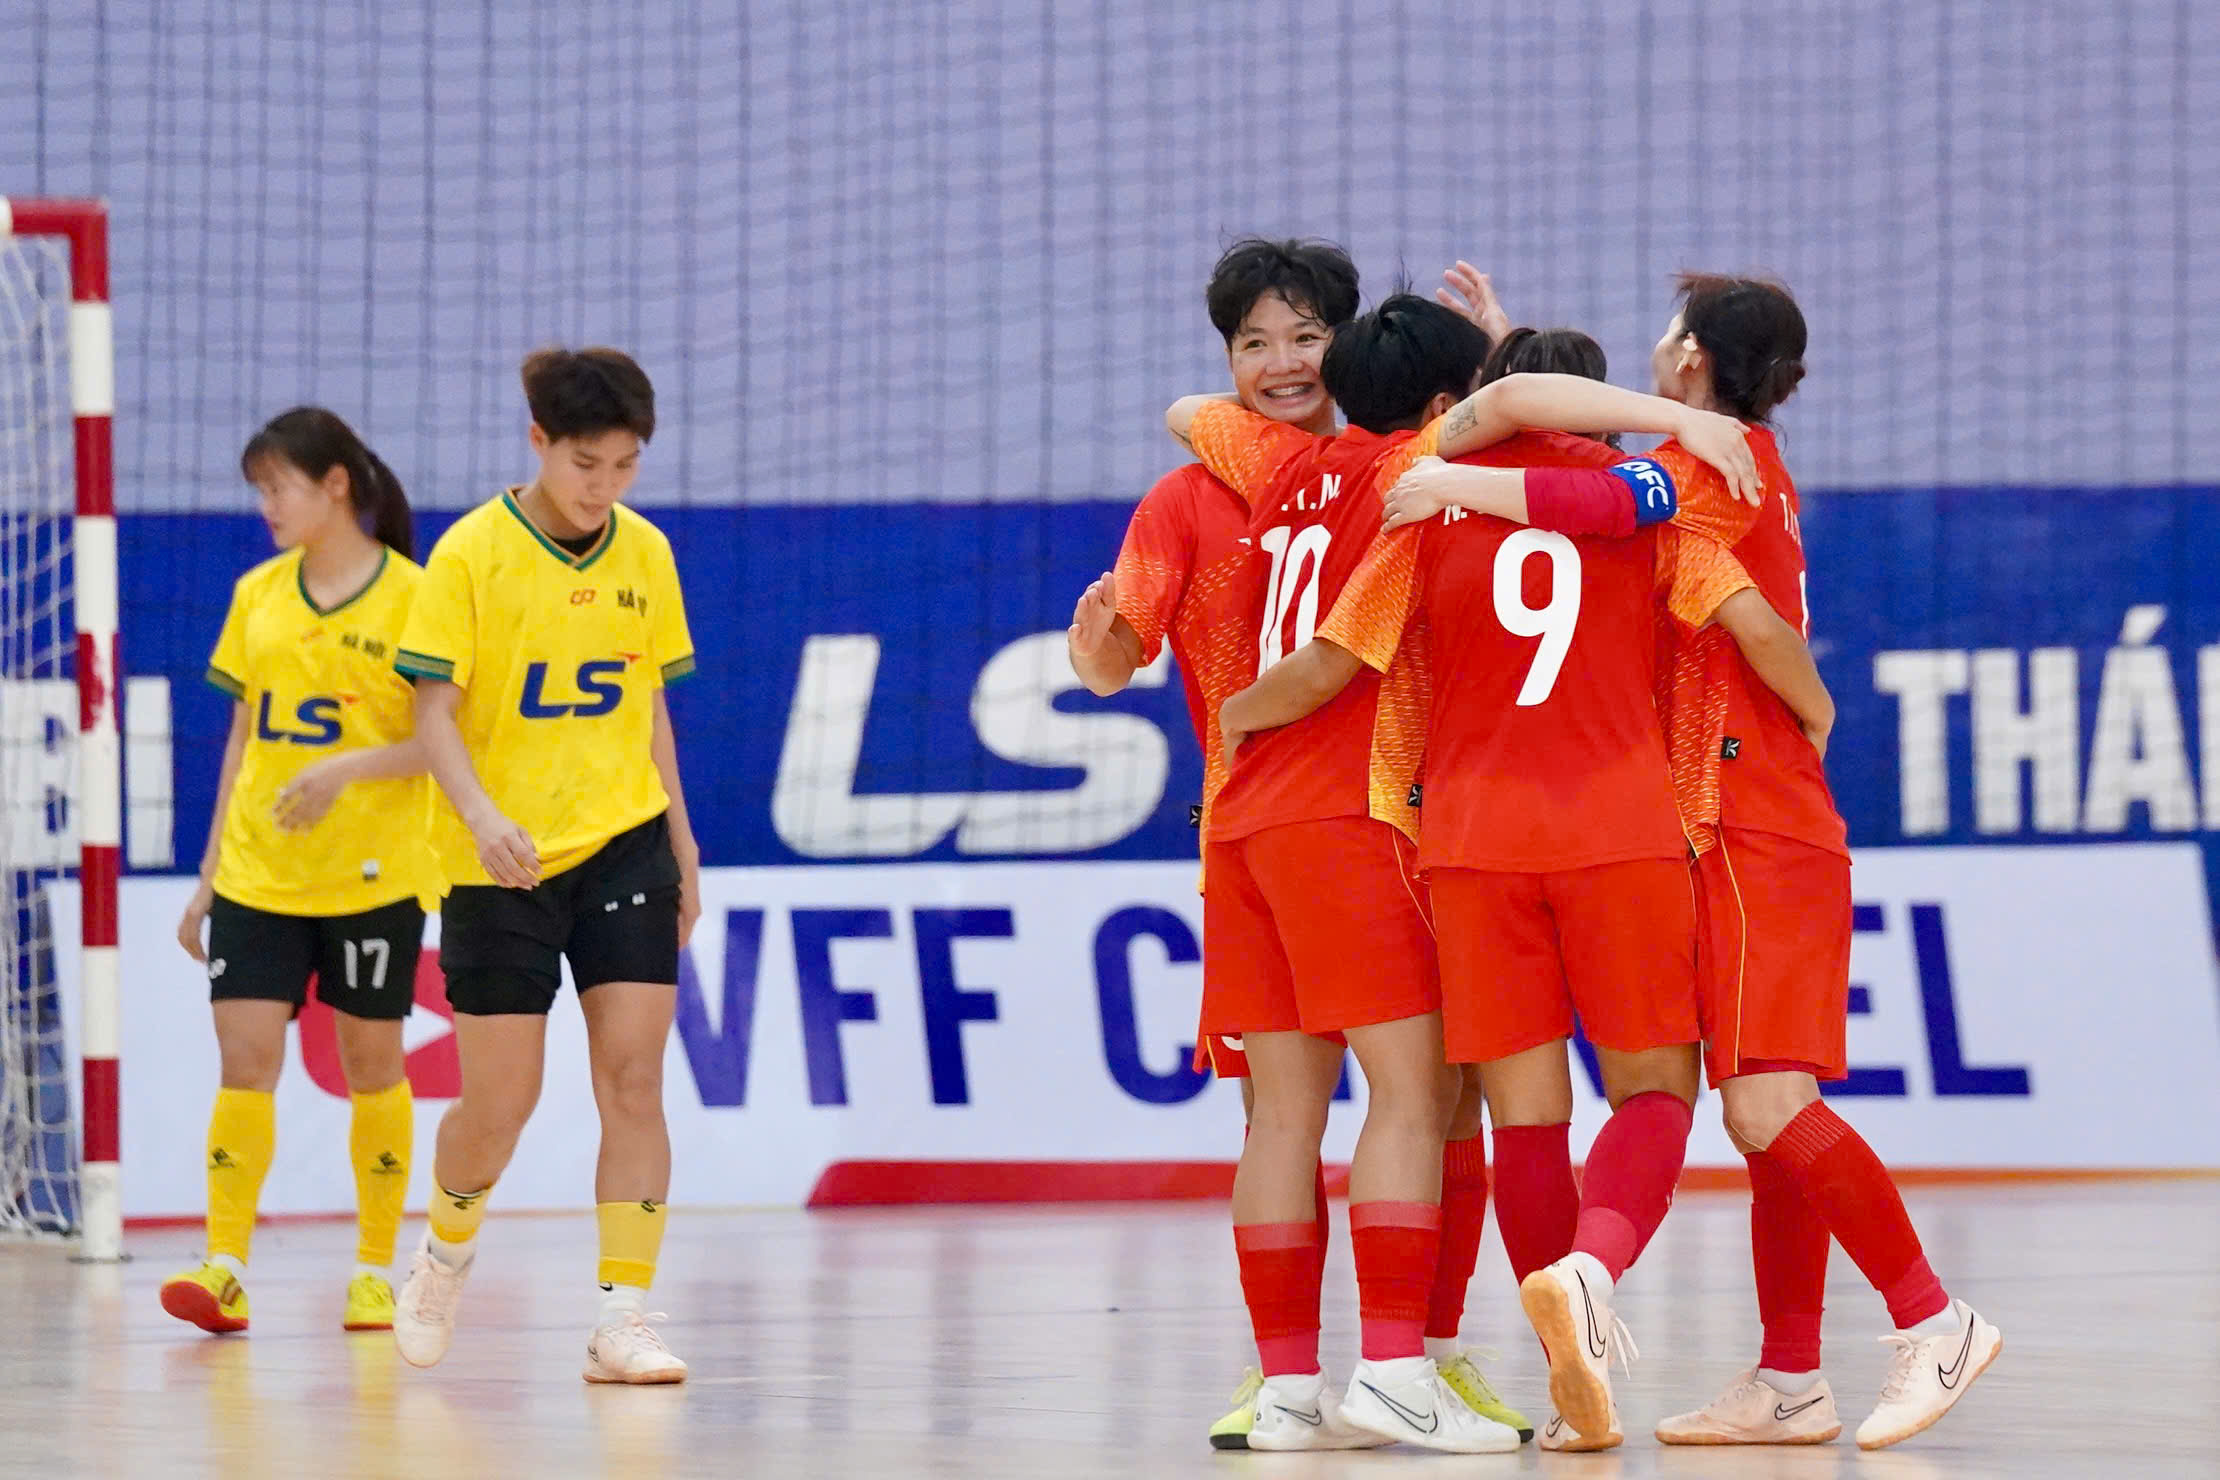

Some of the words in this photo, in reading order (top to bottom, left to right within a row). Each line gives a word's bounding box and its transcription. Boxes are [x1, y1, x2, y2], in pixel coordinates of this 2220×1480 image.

[1261, 524, 1332, 680] 10
[1493, 528, 1582, 706] 9
[258, 690, 342, 744] LS
[519, 661, 626, 718] LS
[771, 631, 1169, 858] LS
[343, 938, 390, 989] 17
